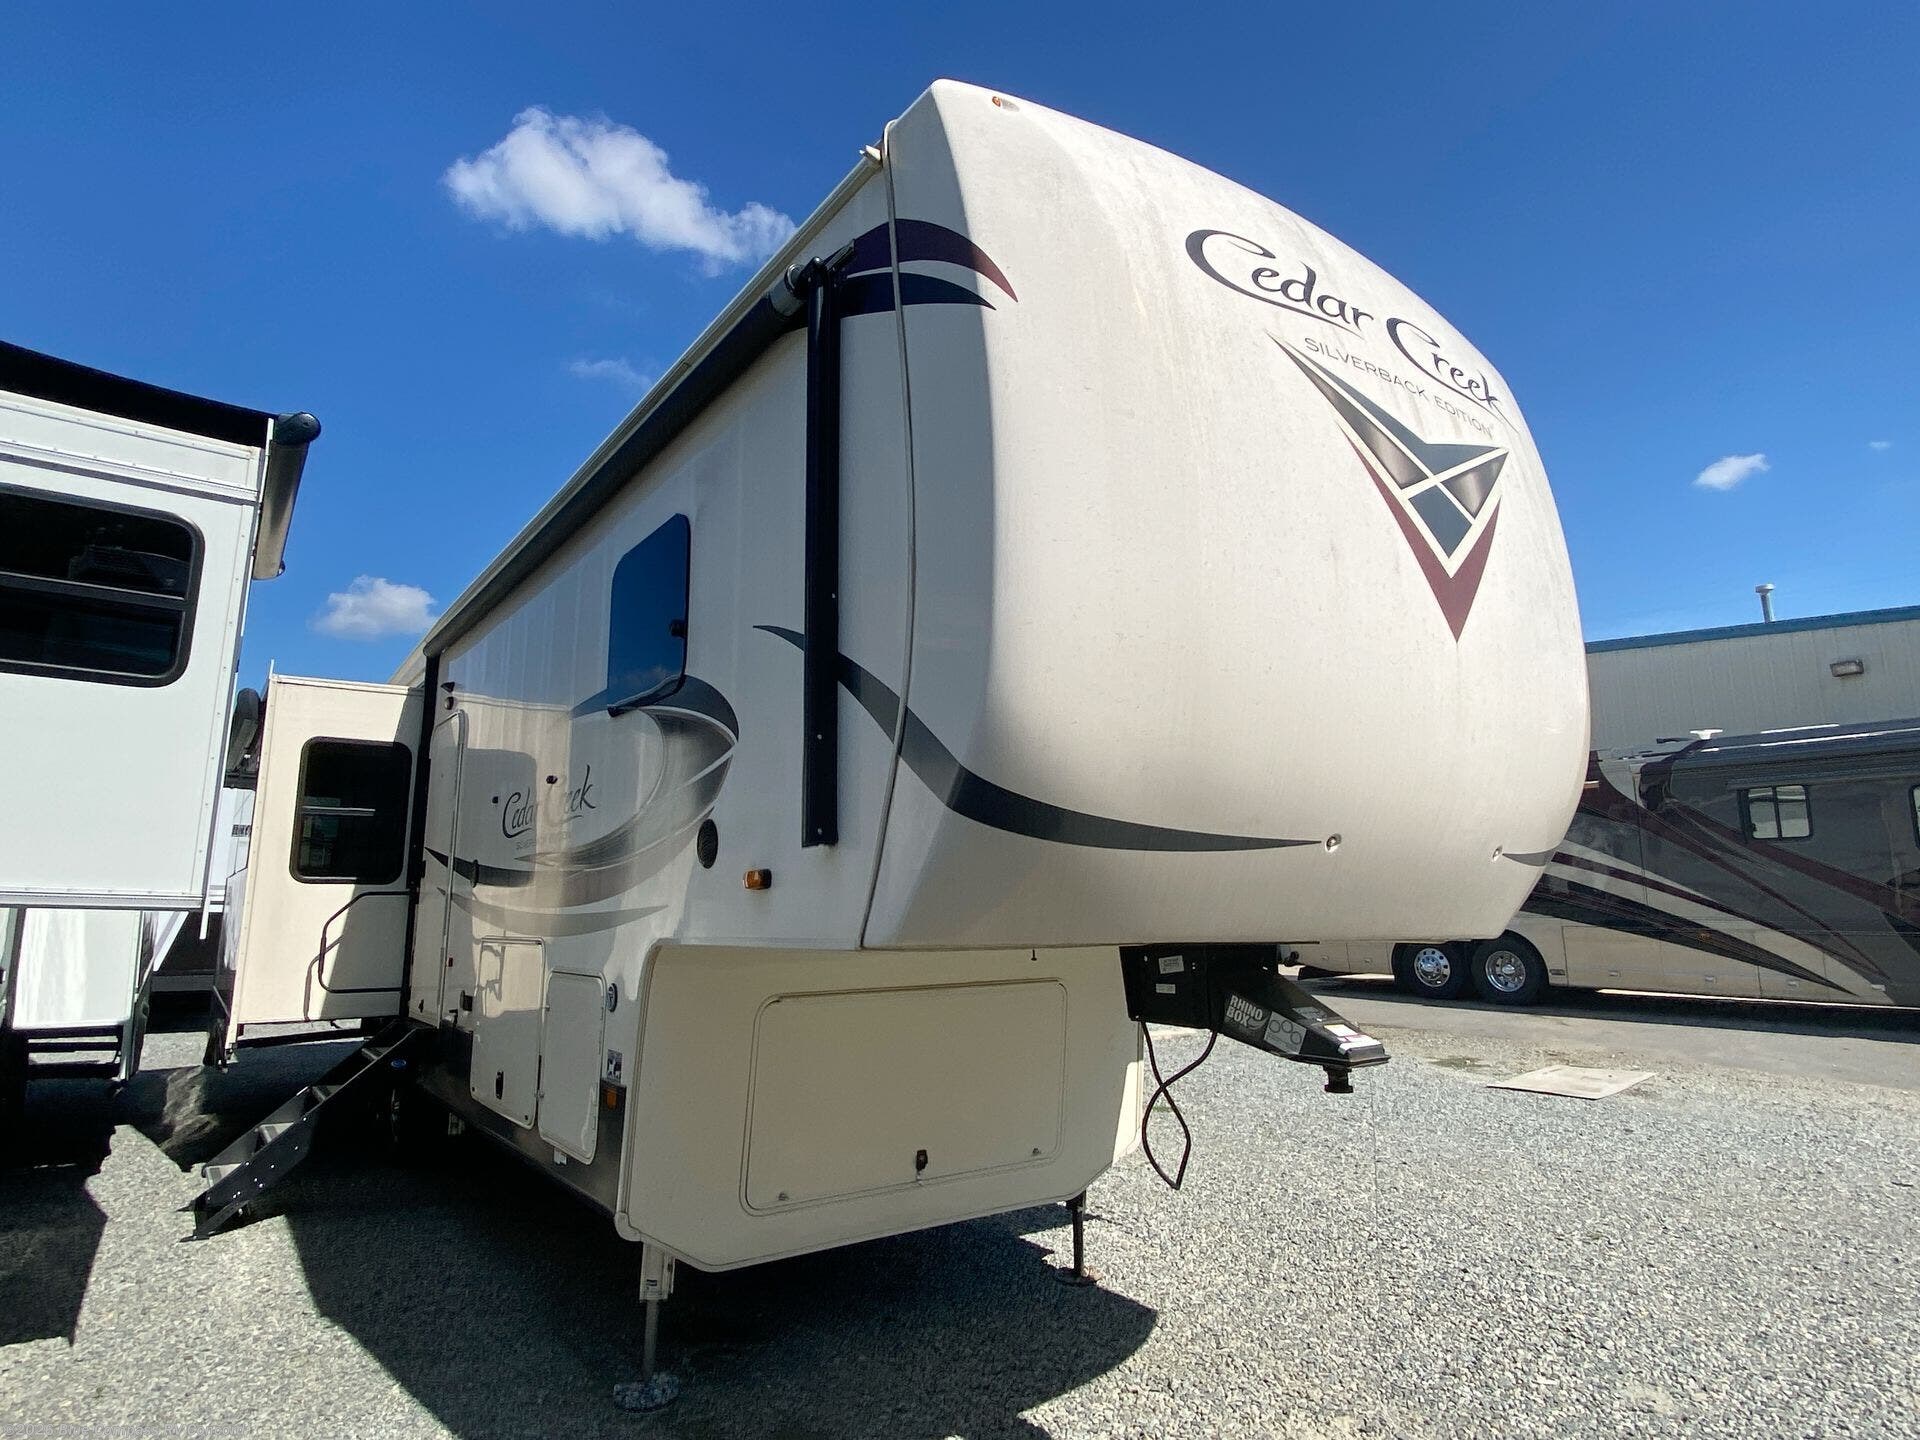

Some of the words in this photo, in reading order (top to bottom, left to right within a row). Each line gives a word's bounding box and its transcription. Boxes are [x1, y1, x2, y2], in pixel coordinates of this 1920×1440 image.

[1185, 229, 1375, 341] Cedar
[1386, 317, 1520, 435] Creek
[1304, 337, 1430, 402] SILVERBACK
[1434, 395, 1494, 440] EDITION
[1226, 1005, 1250, 1027] BOX
[1229, 994, 1264, 1021] RHINO
